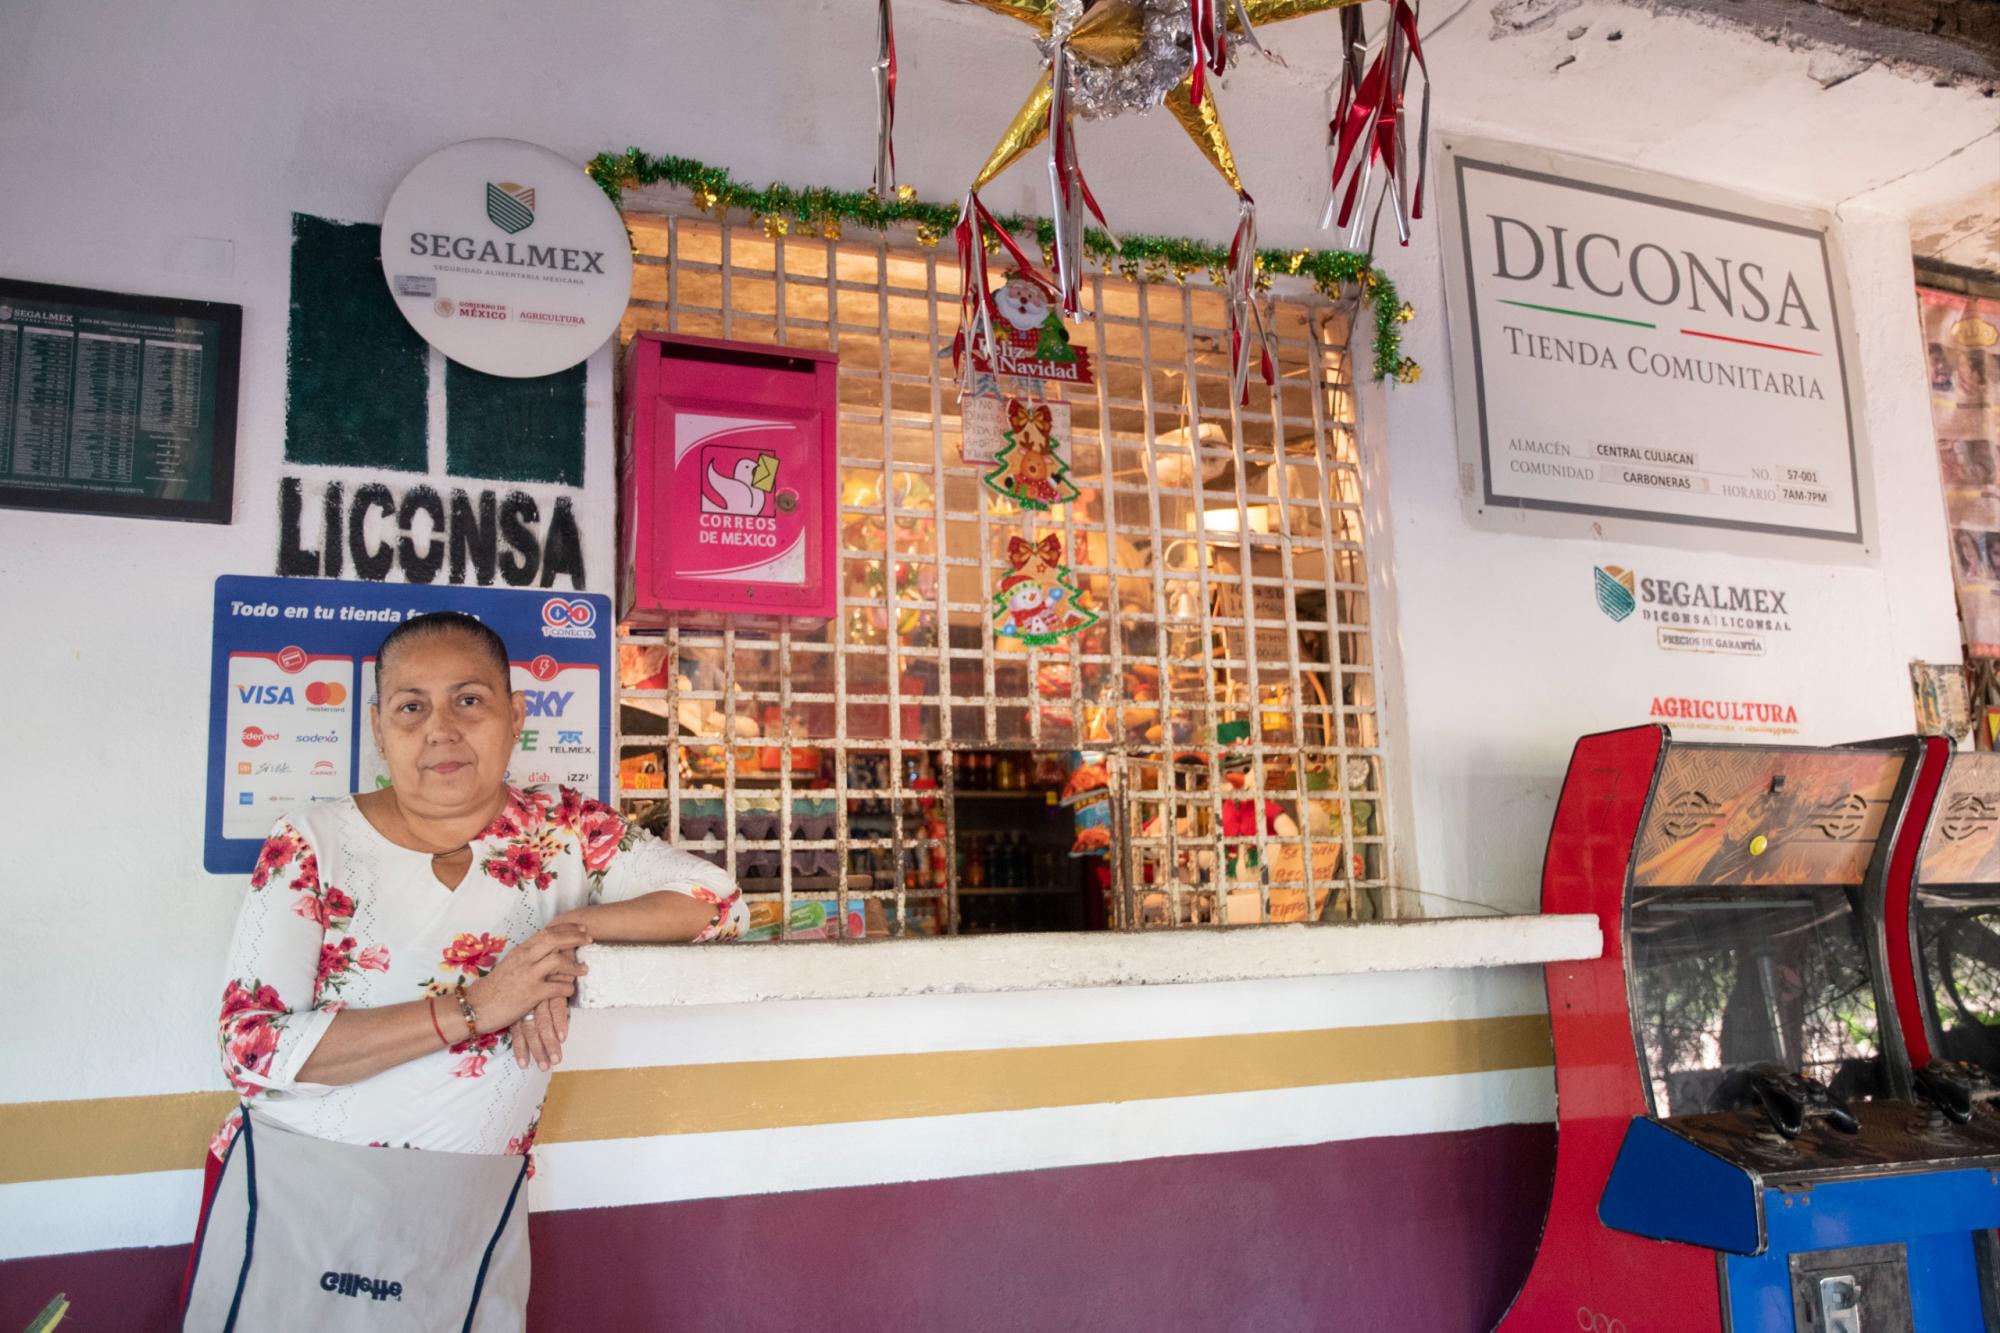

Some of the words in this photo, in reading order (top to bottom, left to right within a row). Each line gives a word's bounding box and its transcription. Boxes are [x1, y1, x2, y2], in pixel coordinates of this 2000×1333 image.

[410, 232, 605, 274] SEGALMEX
[433, 264, 482, 275] SEGURIDAD
[485, 270, 540, 281] ALIMENTARIA
[543, 276, 585, 285] MEXICANA
[1486, 214, 1820, 332] DICONSA
[14, 309, 73, 322] SEGALMEX
[459, 308, 506, 320] MÉXICO
[520, 311, 586, 325] AGRICULTURA
[999, 355, 1078, 379] Navidad
[1503, 325, 1619, 371] TIENDA
[1628, 346, 1825, 400] COMUNITARIA
[1509, 439, 1571, 456] ALMACÉN
[1597, 444, 1642, 460] CENTRAL
[1644, 450, 1694, 466] CULIACAN
[1510, 460, 1594, 481] COMUNIDAD
[1623, 472, 1691, 490] CARBONERAS
[1751, 467, 1772, 482] NO.
[1787, 469, 1817, 483] 57-001
[1722, 484, 1776, 502] HORARIO
[1782, 488, 1828, 503] 7AM-7PM
[700, 514, 776, 531] CORREOS
[277, 477, 586, 590] LICONSA
[700, 531, 718, 544] DE
[1641, 577, 1789, 615] SEGALMEX
[231, 601, 278, 617] Todo
[284, 607, 308, 618] en
[314, 605, 334, 620] tu
[340, 606, 401, 623] tienda
[1642, 609, 1710, 625] DICONSA
[1663, 634, 1700, 647] PRECIOS
[1702, 637, 1714, 648] DE
[236, 685, 295, 705] VISA
[525, 689, 575, 718] SKY
[1650, 697, 1799, 723] AGRICULTURA
[296, 732, 339, 743] sodexo
[549, 746, 592, 754] TELMEX
